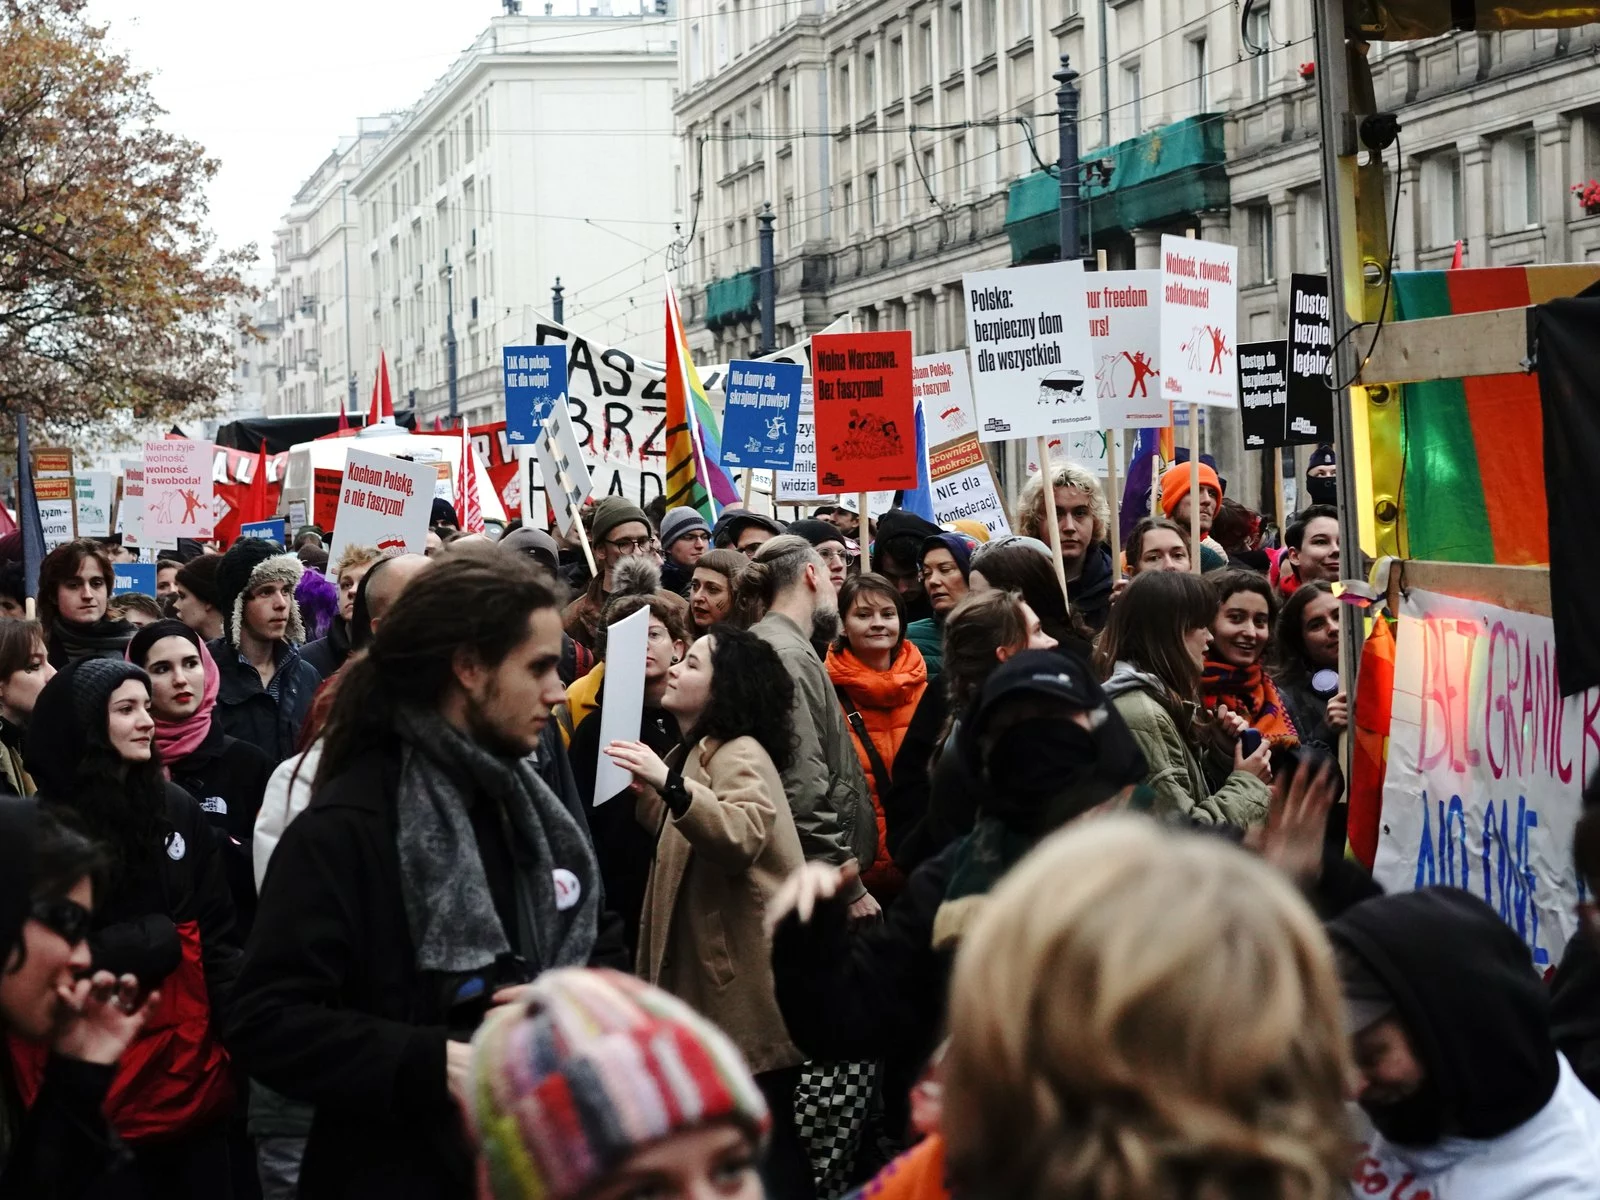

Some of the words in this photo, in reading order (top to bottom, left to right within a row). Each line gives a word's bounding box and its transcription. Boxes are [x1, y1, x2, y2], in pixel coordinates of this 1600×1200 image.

[1165, 252, 1198, 280] Wolność,
[1199, 258, 1232, 285] równość,
[971, 286, 1014, 312] Polska:
[1103, 285, 1148, 309] freedom
[1165, 282, 1209, 309] solidarność!
[1295, 289, 1330, 320] Dostę
[974, 317, 1036, 345] bezpieczny
[1038, 311, 1063, 336] dom
[1089, 315, 1109, 337] urs!
[1294, 318, 1331, 349] bezpie
[817, 349, 846, 371] Wolna
[848, 348, 899, 371] Warszawa.
[978, 348, 996, 373] dla
[997, 341, 1062, 372] wszystkich
[1293, 348, 1333, 380] legalne
[731, 370, 743, 385] Nie
[743, 371, 764, 389] damy
[764, 373, 776, 391] się
[912, 365, 930, 380] cham
[929, 362, 954, 378] Polskę,
[729, 389, 759, 409] skrajnej
[759, 392, 791, 410] prawicy!
[818, 379, 834, 400] Bez
[836, 376, 884, 401] faszyzmu!
[922, 380, 951, 398] faszyzm!
[145, 442, 174, 451] Niech
[175, 442, 195, 452] żyje
[145, 453, 185, 463] wolność
[929, 441, 978, 464] acownicza
[145, 464, 188, 474] wolność
[930, 453, 979, 476] emokracja
[145, 476, 149, 485] i
[151, 476, 201, 485] swoboda!
[347, 461, 383, 487] Kocham
[383, 470, 414, 497] Polskę,
[781, 479, 816, 492] widzia
[936, 482, 959, 501] NIE
[961, 475, 981, 492] dla
[343, 488, 350, 504] a
[351, 488, 366, 507] nie
[366, 490, 405, 517] faszyzm!
[935, 492, 998, 526] Konfederacji
[40, 509, 62, 520] zyzm
[43, 525, 67, 534] worne
